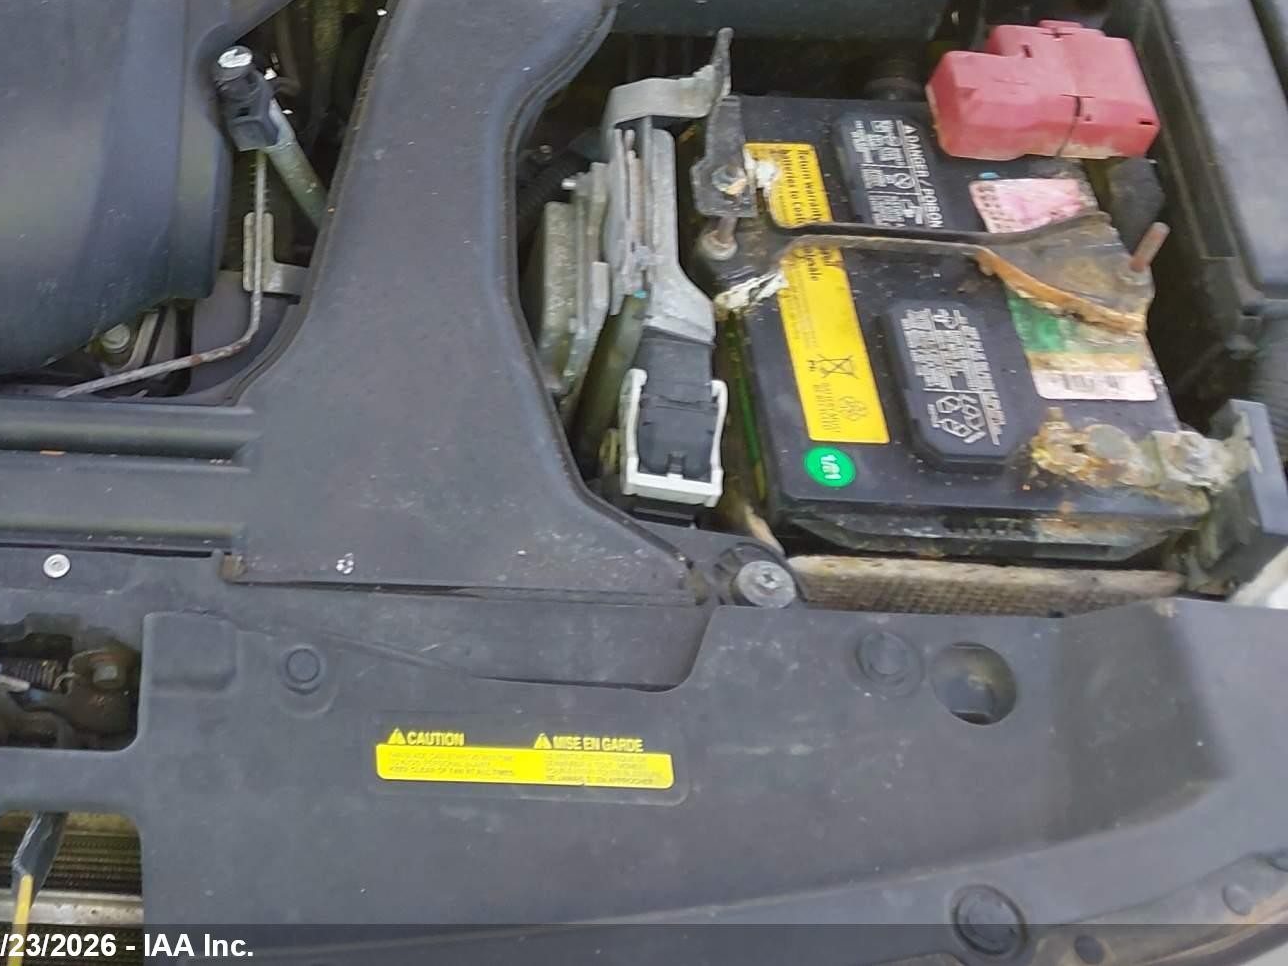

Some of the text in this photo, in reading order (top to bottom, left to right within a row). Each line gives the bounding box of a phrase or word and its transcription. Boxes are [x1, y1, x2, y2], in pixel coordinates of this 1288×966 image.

[904, 135, 930, 177] DANGER
[921, 188, 944, 228] POISON
[407, 732, 464, 746] CAUTION
[553, 736, 643, 752] MISE EN GARDE
